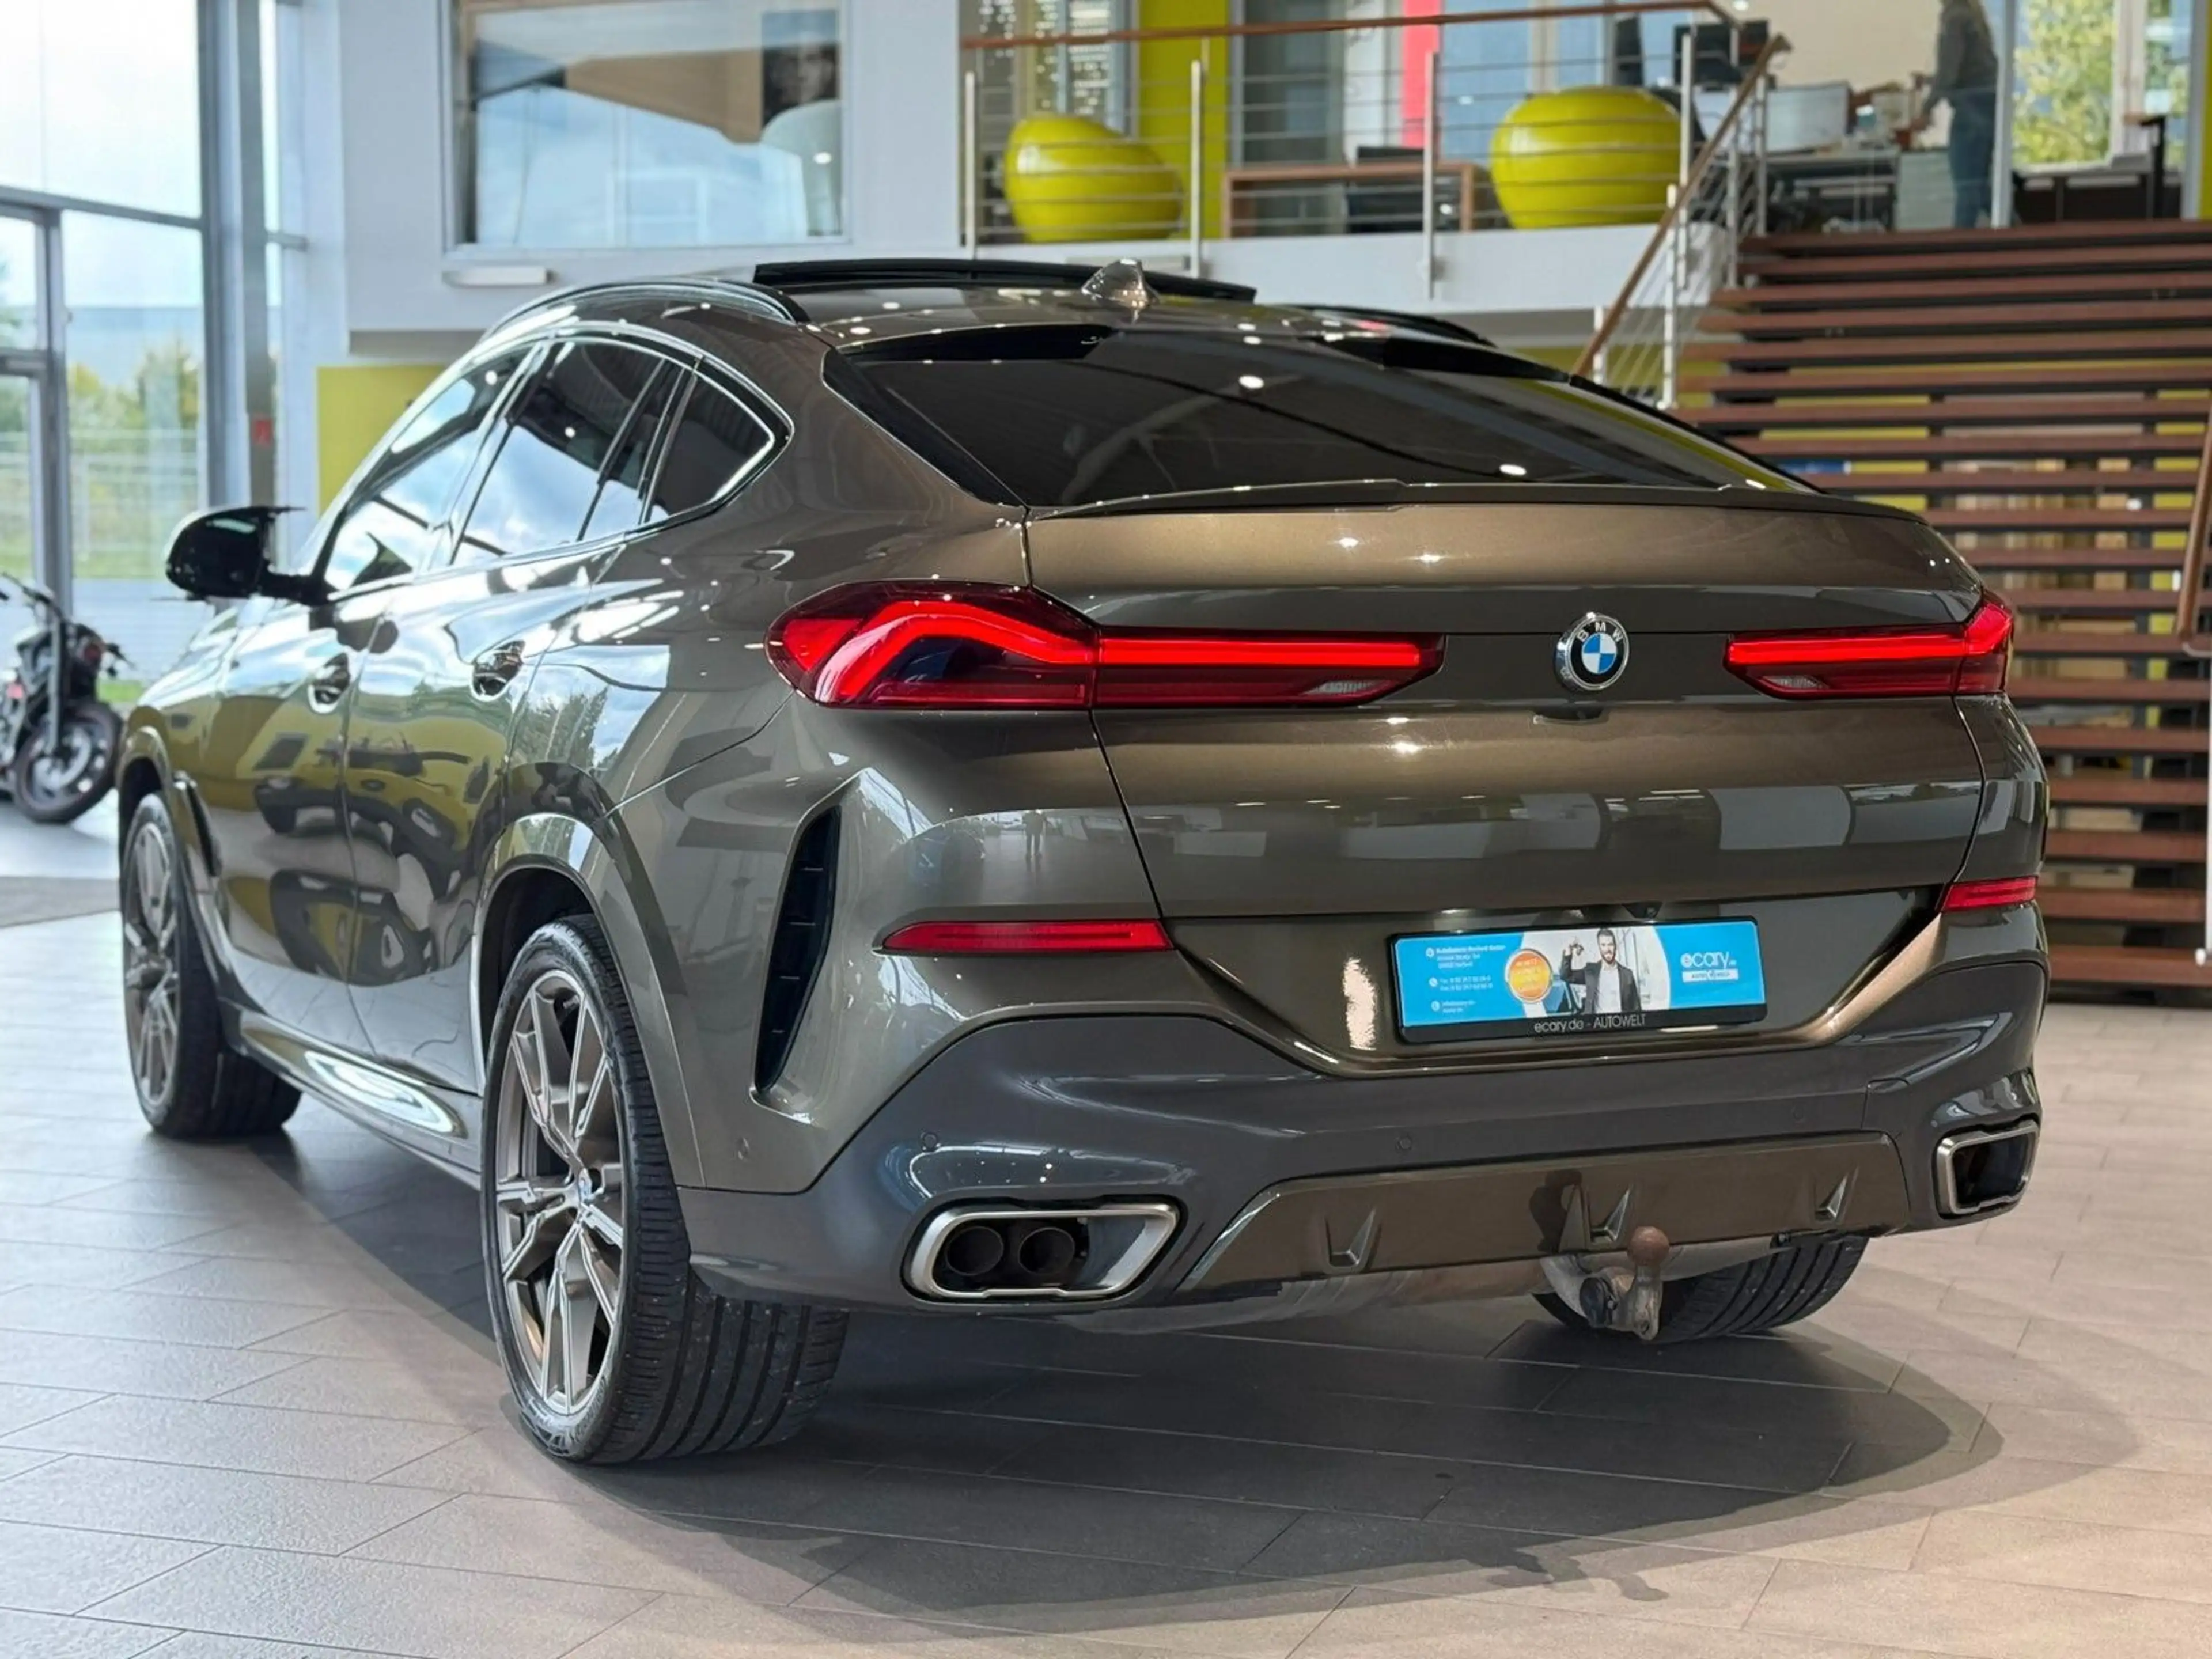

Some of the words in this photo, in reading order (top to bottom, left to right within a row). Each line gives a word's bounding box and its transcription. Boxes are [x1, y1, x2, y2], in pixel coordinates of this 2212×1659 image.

[1576, 622, 1624, 642] BMW
[1534, 1018, 1584, 1033] ecary.de
[1593, 1014, 1646, 1029] AUTOWELT
